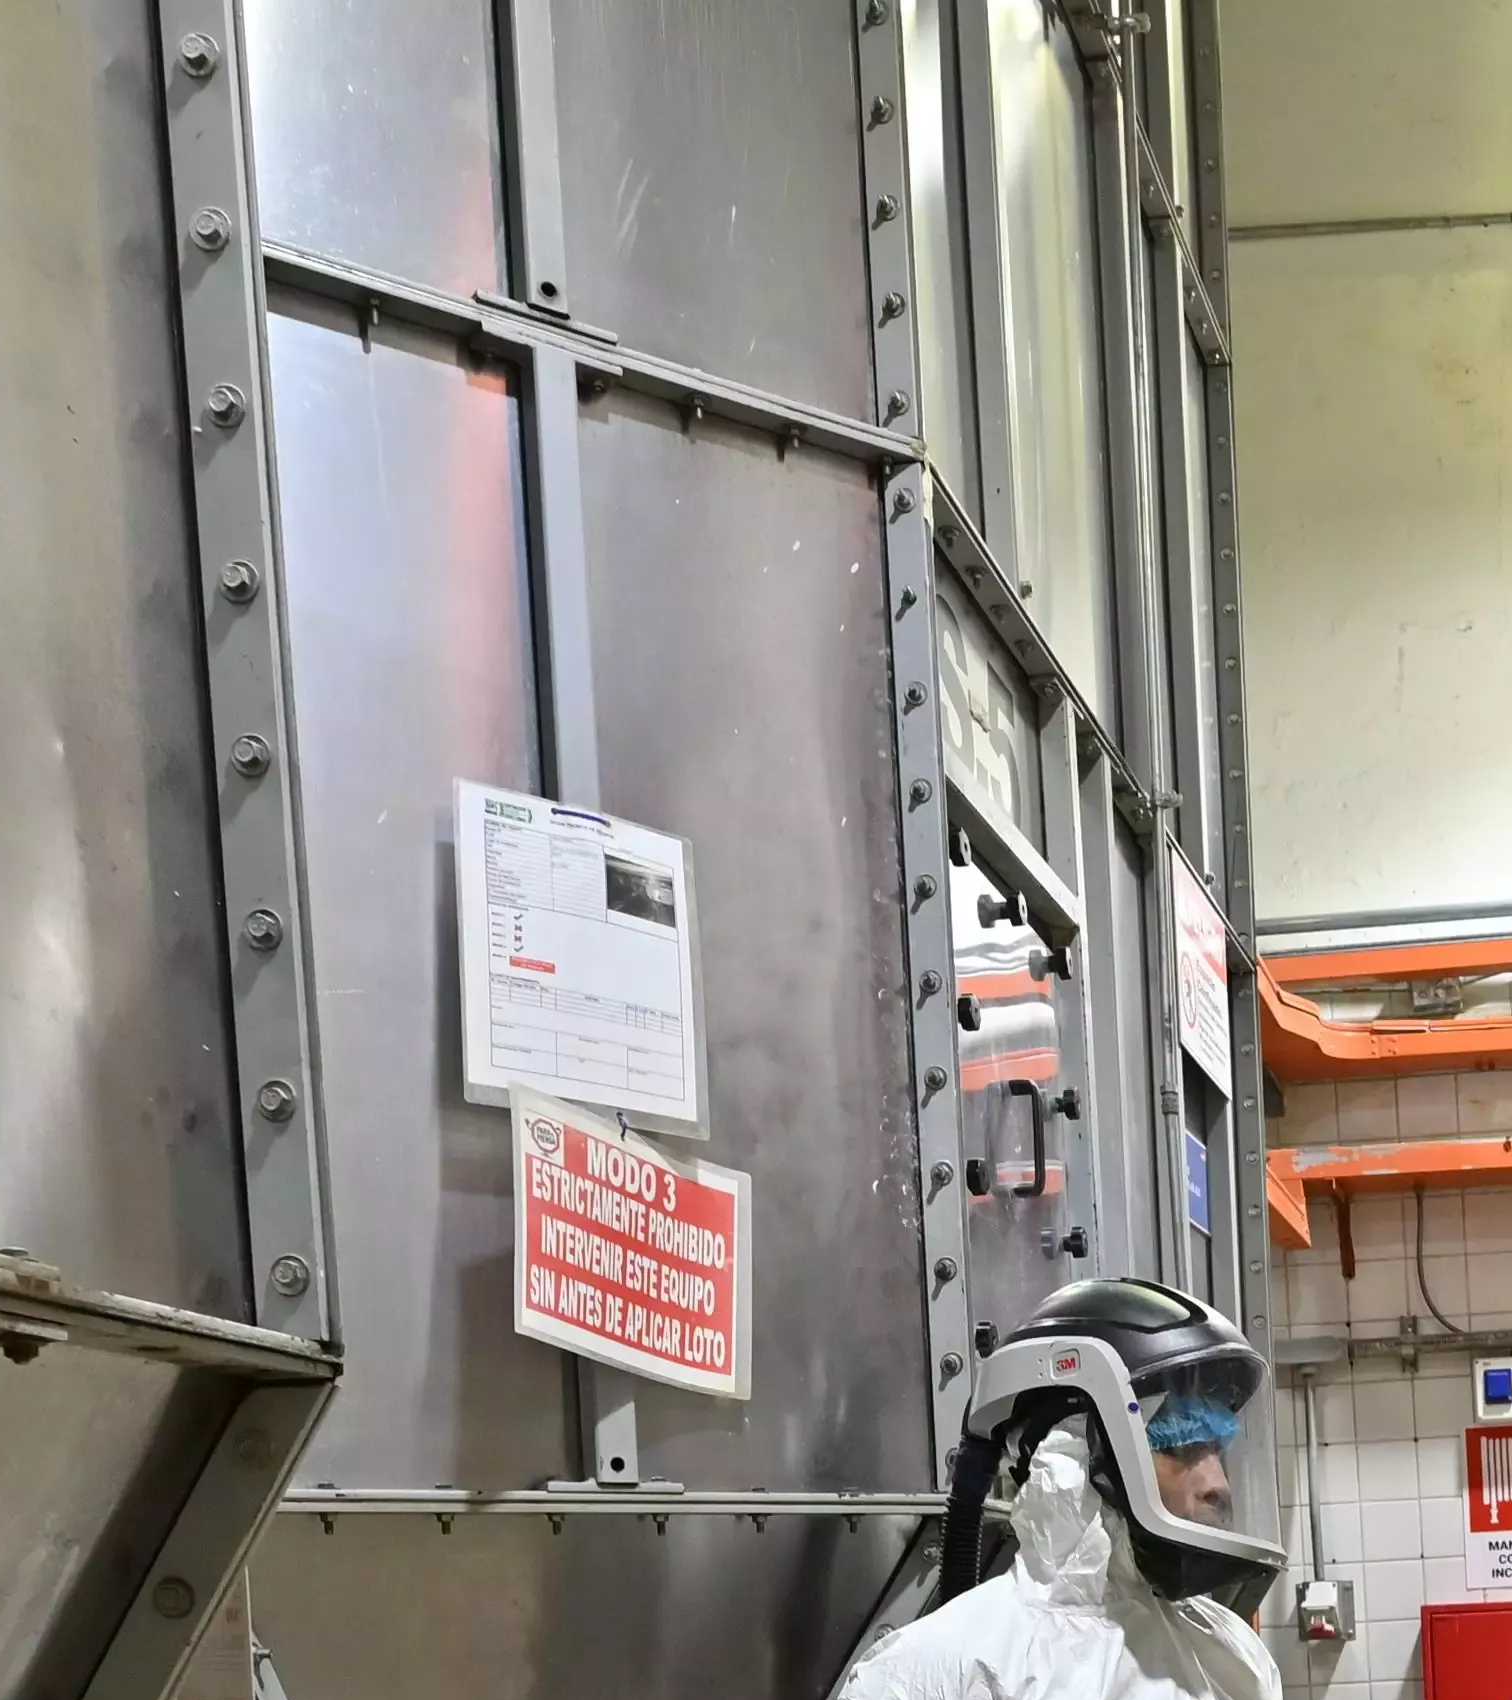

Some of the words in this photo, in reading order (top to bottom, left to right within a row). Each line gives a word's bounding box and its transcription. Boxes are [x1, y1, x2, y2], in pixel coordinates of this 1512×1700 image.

[532, 1158, 646, 1242] ESTRICTAMENTE
[648, 1208, 726, 1270] PROHIBIDO
[586, 1136, 657, 1202] MODO
[663, 1174, 677, 1212] 3
[530, 1264, 556, 1310] SIN
[558, 1275, 603, 1328] ANTES
[605, 1292, 624, 1337] DE
[625, 1304, 681, 1360] APLICAR
[684, 1322, 725, 1368] LOTO
[541, 1214, 624, 1285] INTERVENIR
[625, 1250, 658, 1299] ESTE
[660, 1263, 715, 1316] EQUIPO
[1056, 1356, 1076, 1372] 3M
